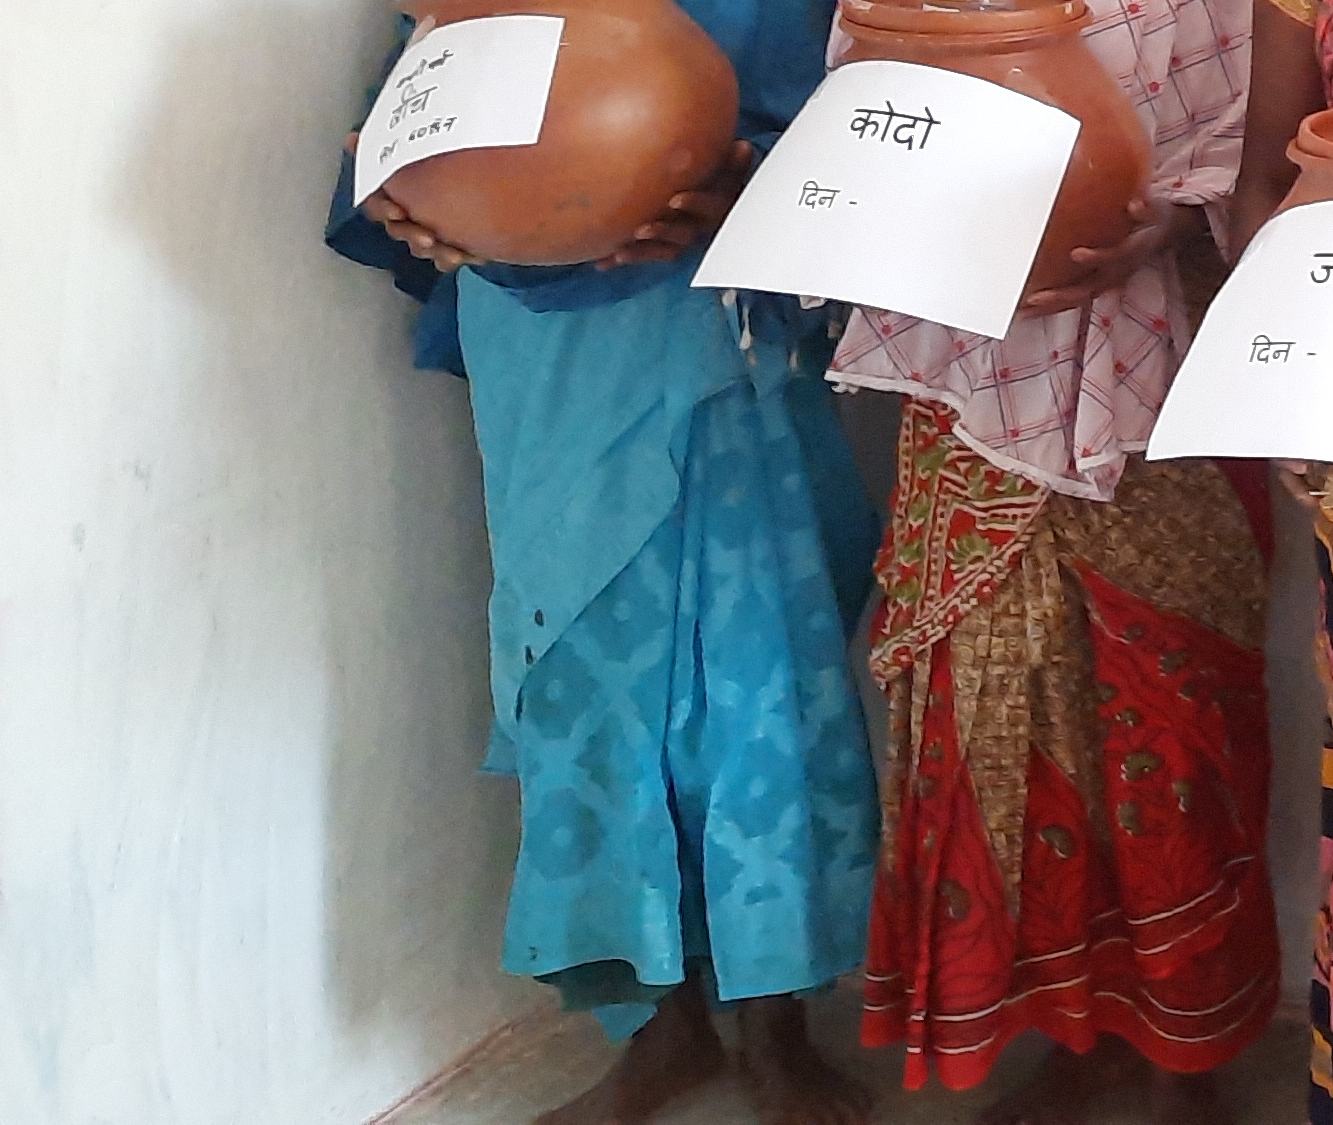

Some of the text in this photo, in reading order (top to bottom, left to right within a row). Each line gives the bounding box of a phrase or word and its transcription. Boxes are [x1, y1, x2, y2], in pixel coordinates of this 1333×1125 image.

[849, 100, 942, 151] कोदो
[798, 180, 841, 209] दिन
[1248, 334, 1297, 364] दिन
